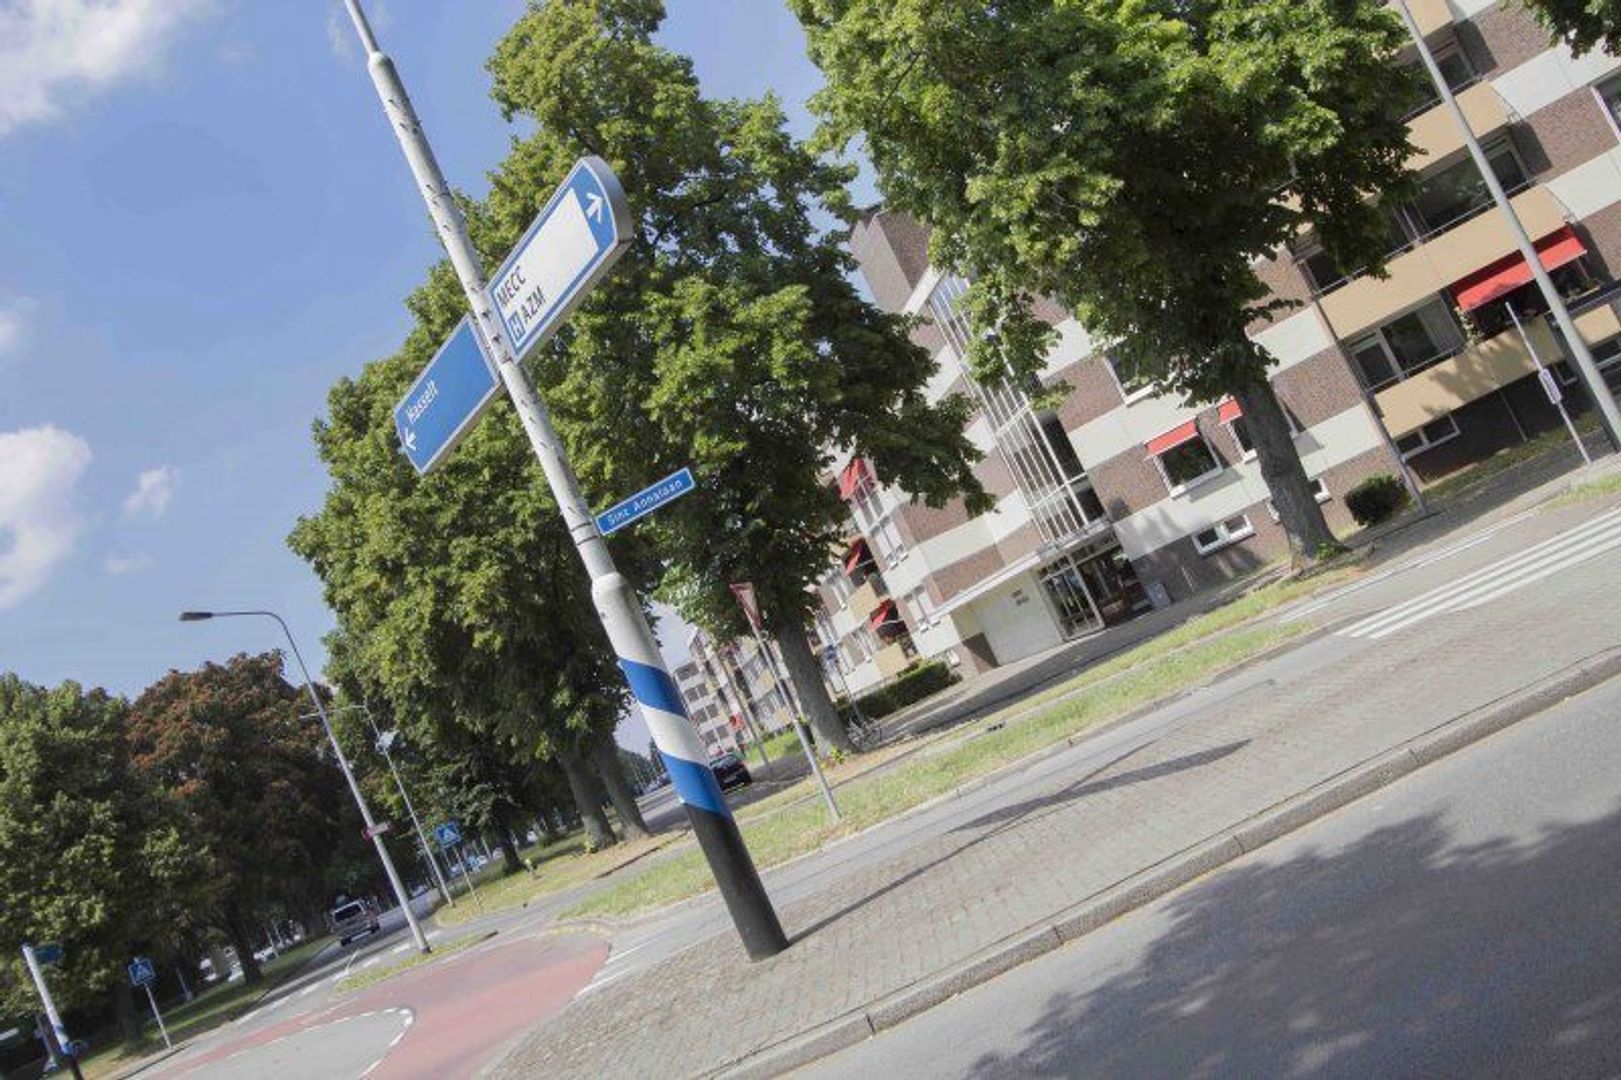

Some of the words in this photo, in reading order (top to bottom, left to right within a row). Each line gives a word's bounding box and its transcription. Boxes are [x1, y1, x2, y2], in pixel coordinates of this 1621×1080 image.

[497, 265, 526, 308] MECC
[521, 285, 546, 325] AZM
[405, 379, 438, 424] Hasselt
